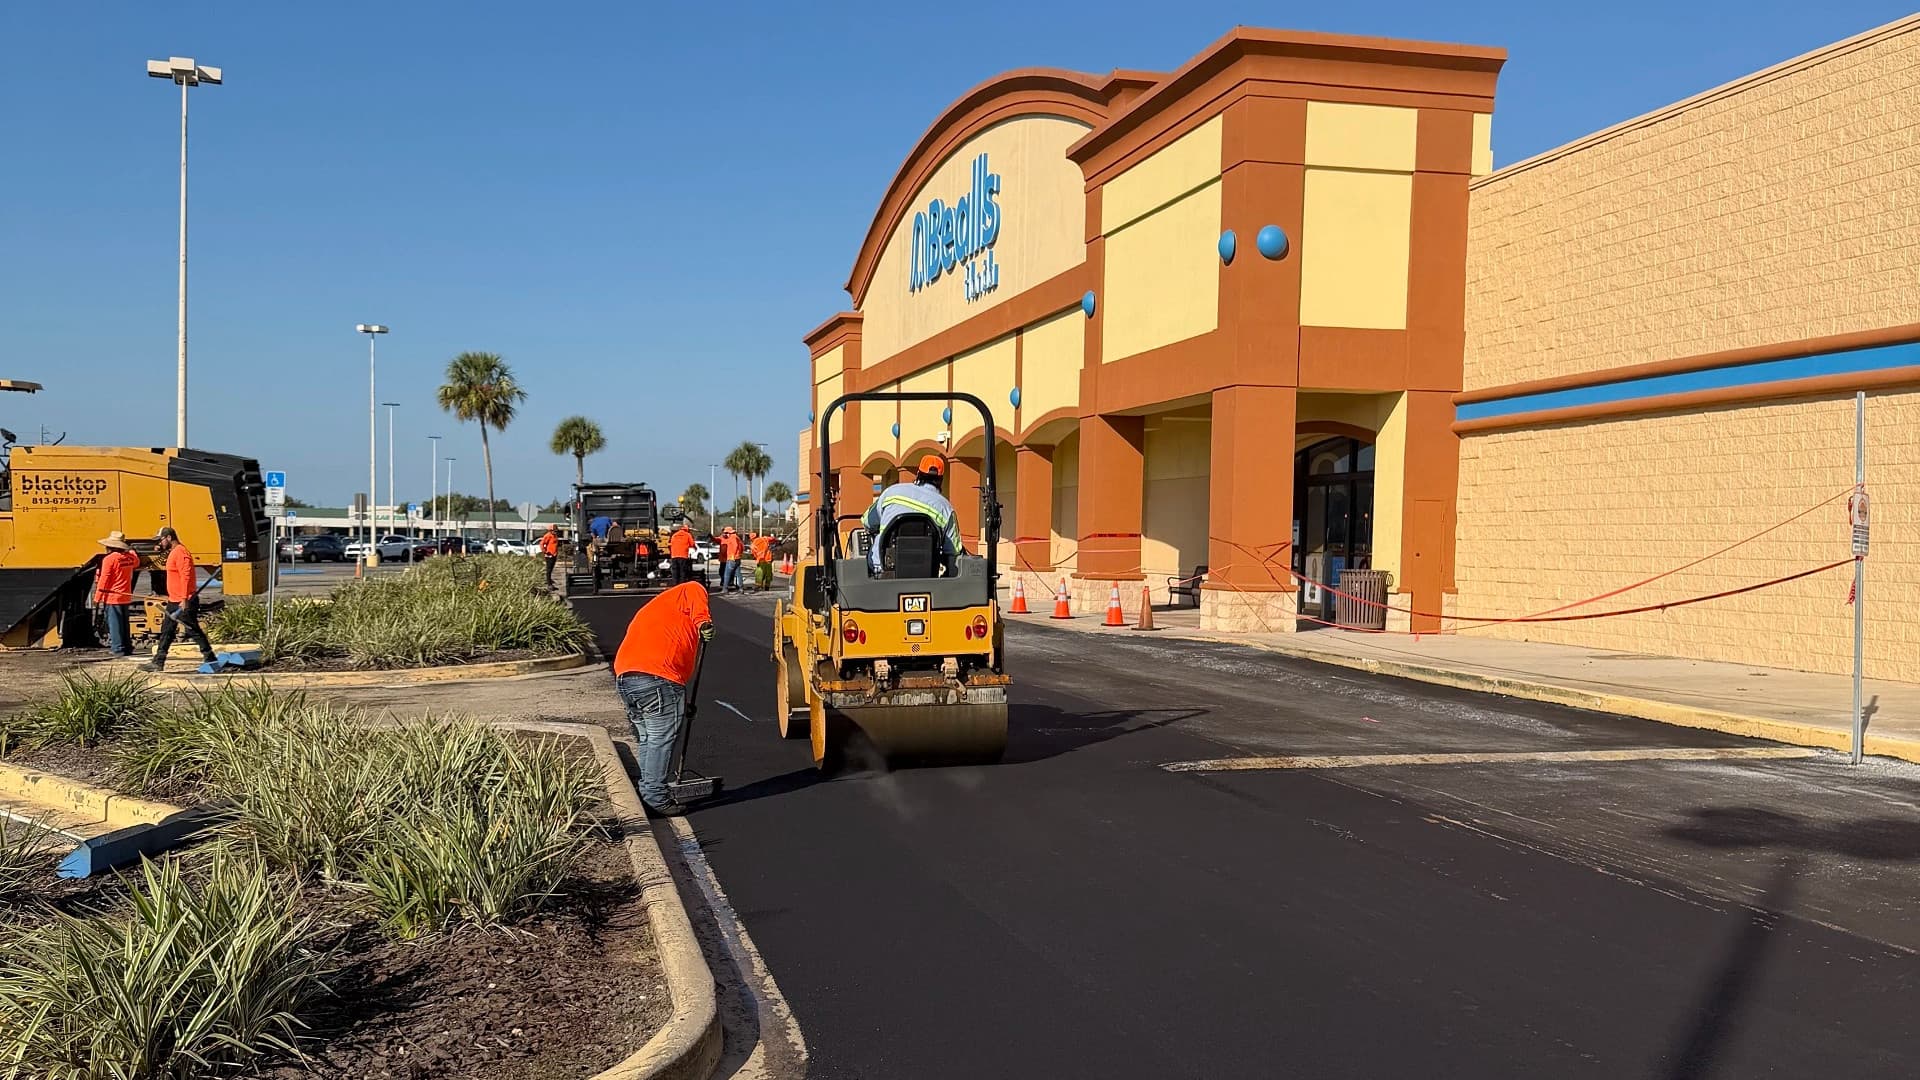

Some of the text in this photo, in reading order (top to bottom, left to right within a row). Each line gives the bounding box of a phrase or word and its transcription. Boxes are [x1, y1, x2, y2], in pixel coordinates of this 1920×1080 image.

[22, 475, 107, 495] blacktop
[32, 497, 97, 505] 813-675-9775
[905, 598, 926, 611] CAT
